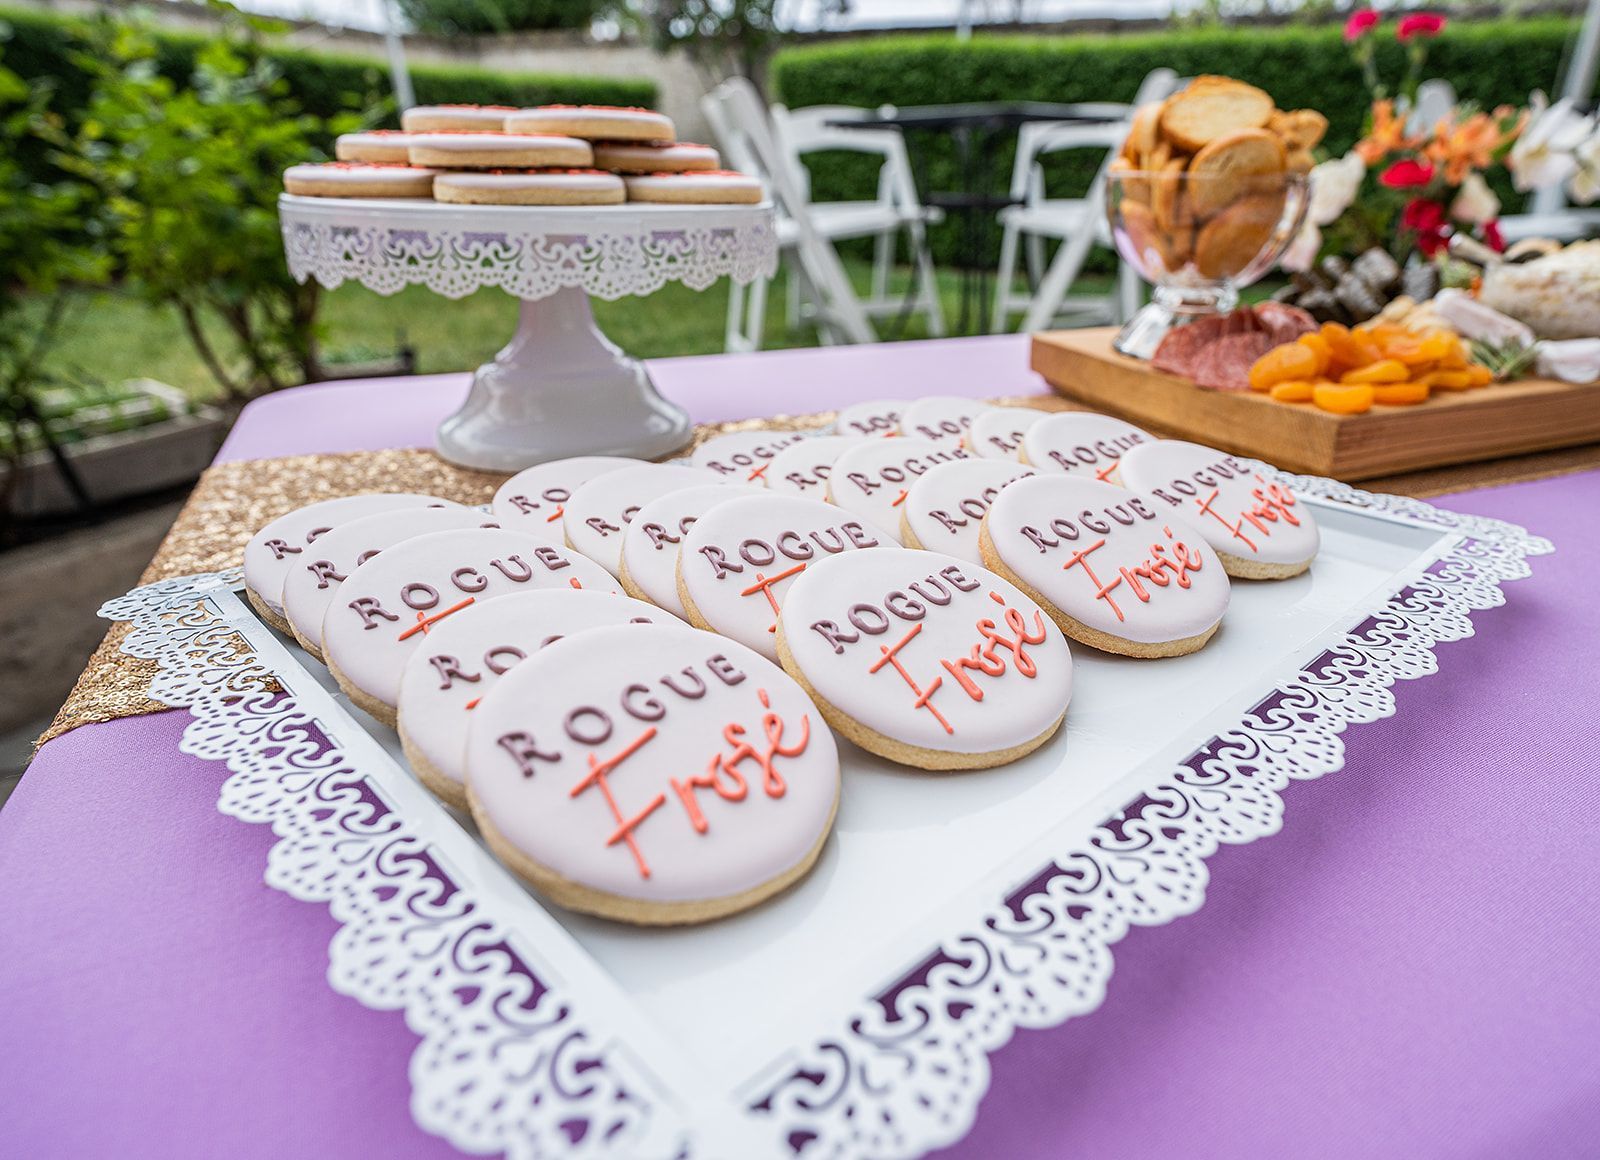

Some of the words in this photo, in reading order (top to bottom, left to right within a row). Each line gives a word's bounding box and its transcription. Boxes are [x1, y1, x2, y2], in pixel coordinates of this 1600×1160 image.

[928, 471, 1036, 534] ROG
[1152, 454, 1251, 507] ROGUE
[1195, 474, 1301, 553] Frosé
[698, 521, 879, 579] ROGUE
[1020, 497, 1157, 553] ROGUE
[348, 546, 570, 630] ROGUE
[810, 565, 981, 654] ROGUE
[1063, 525, 1203, 622] Frosé
[869, 591, 1046, 734] Frosé
[497, 654, 747, 778] ROGUE
[569, 688, 810, 880] Frosé
